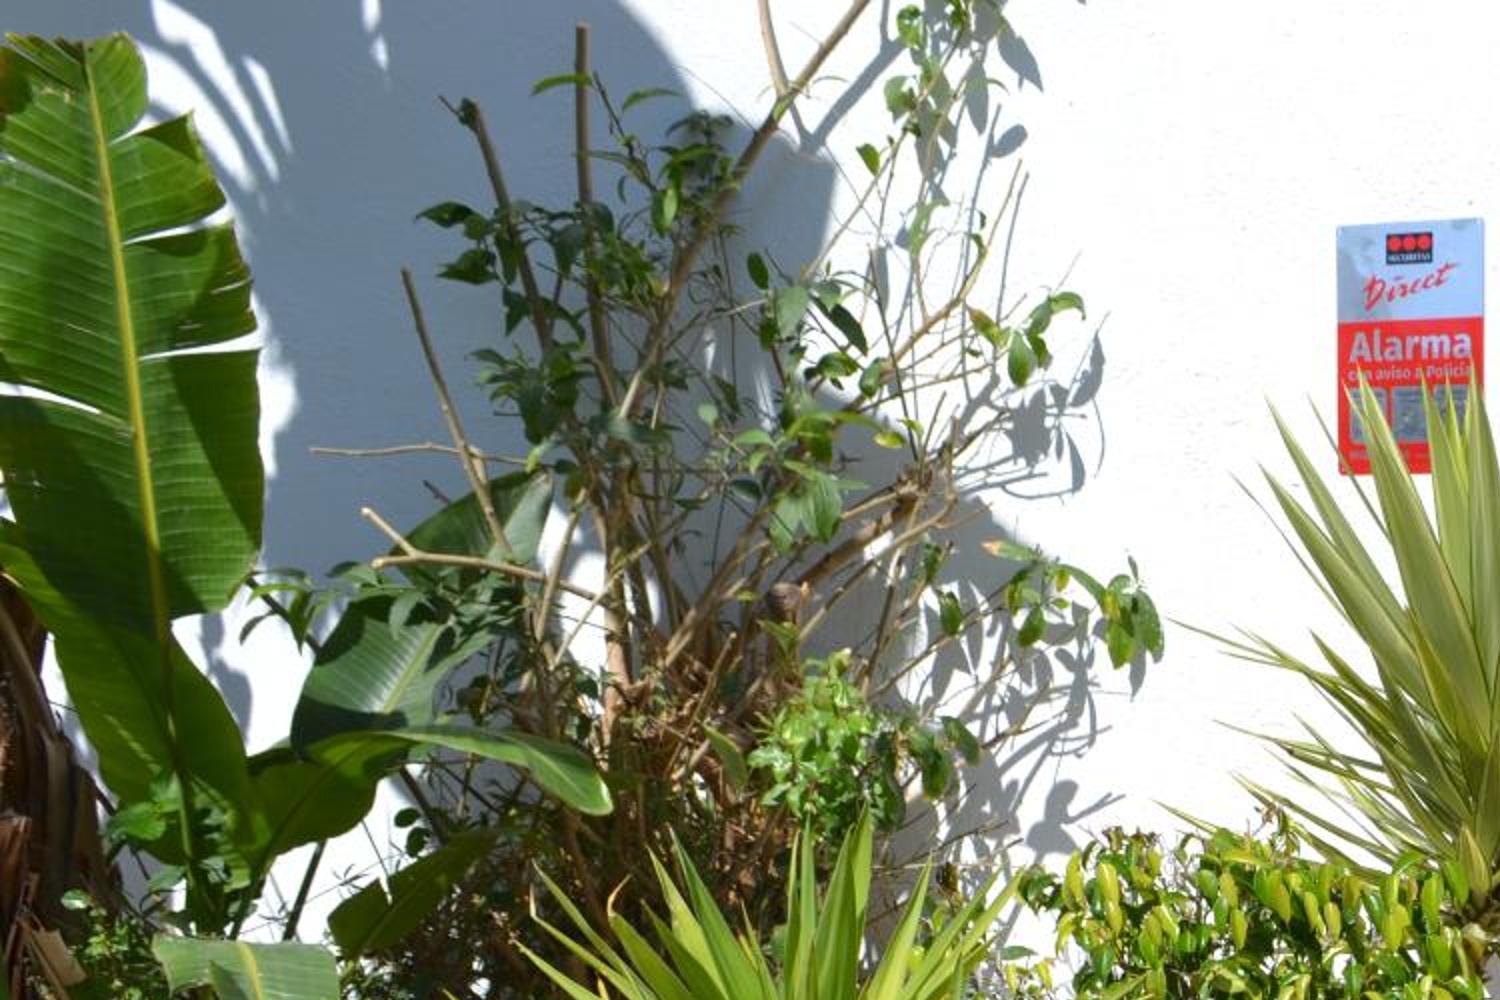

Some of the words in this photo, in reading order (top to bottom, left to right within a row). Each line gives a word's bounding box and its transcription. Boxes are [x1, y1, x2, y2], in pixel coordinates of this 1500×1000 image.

[1363, 262, 1457, 312] Direct
[1350, 329, 1472, 362] Alarma
[1348, 368, 1373, 381] cn
[1376, 366, 1411, 380] aviso
